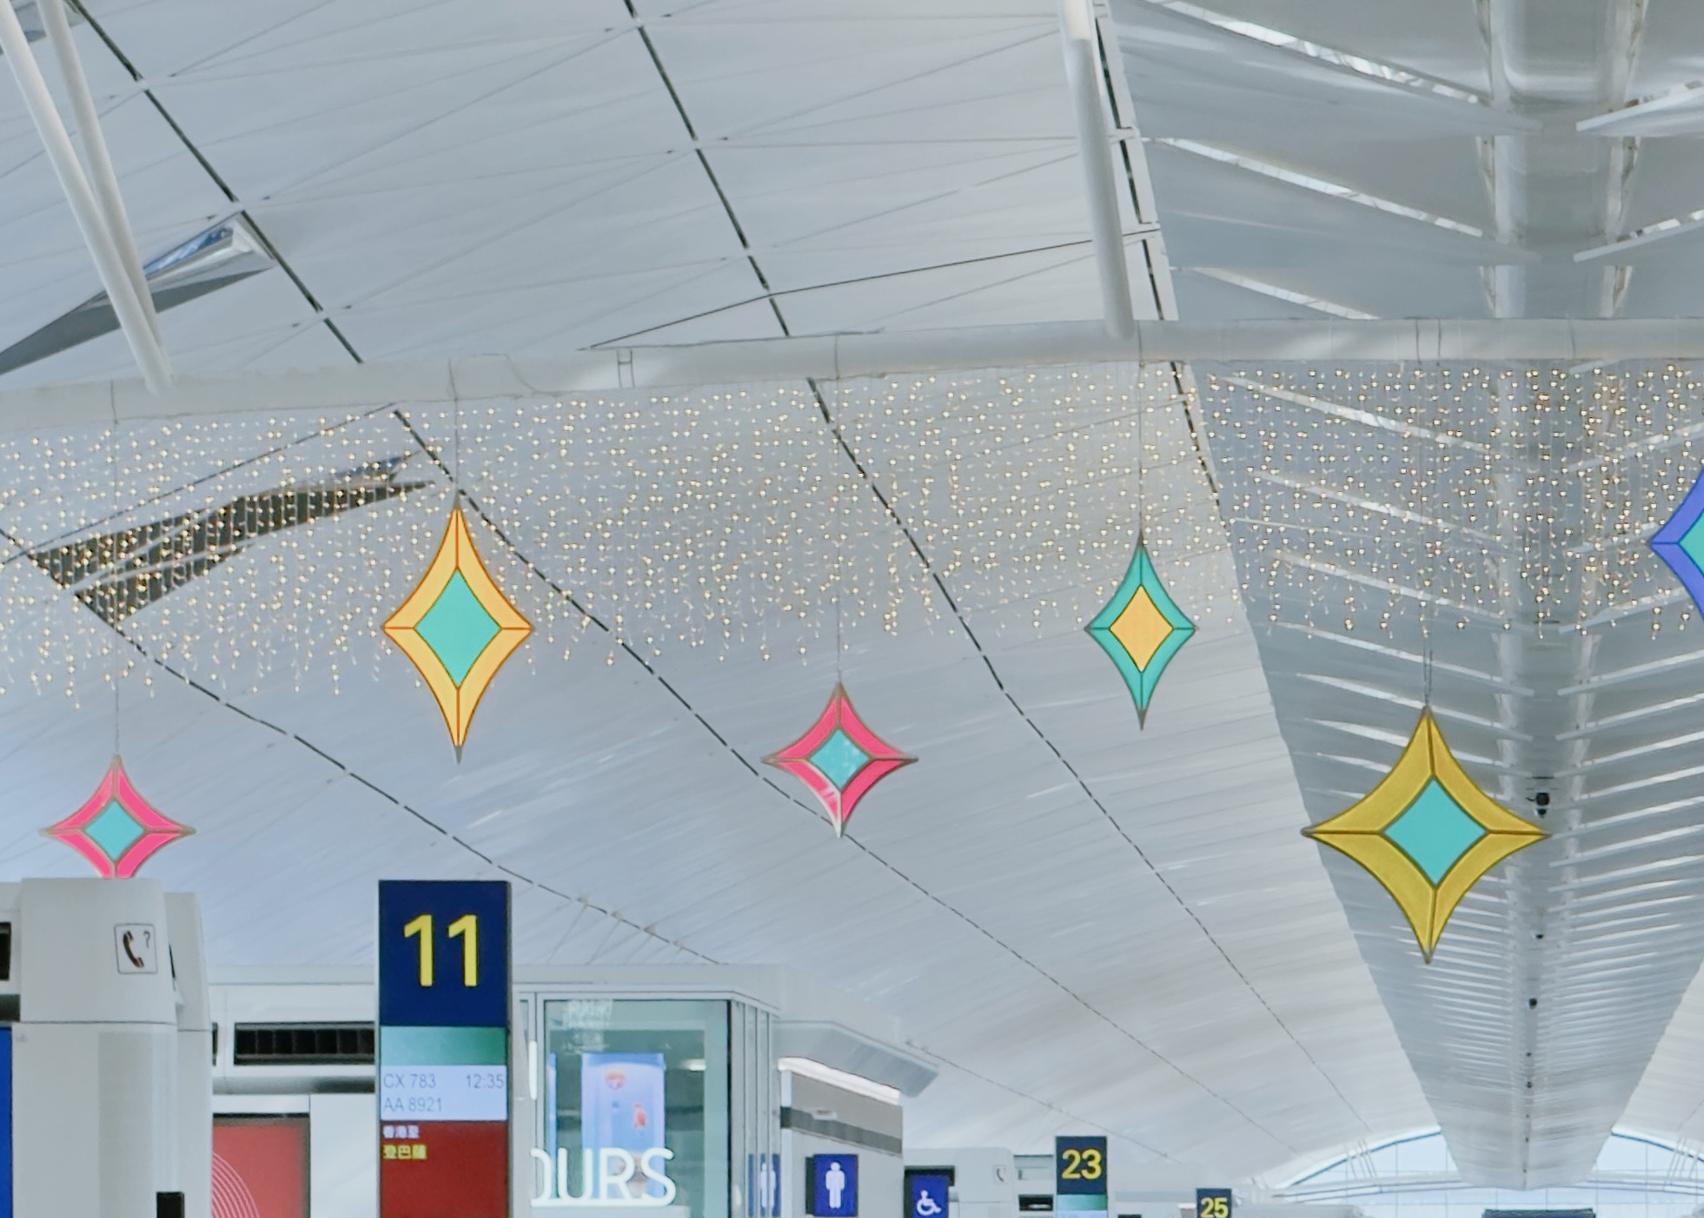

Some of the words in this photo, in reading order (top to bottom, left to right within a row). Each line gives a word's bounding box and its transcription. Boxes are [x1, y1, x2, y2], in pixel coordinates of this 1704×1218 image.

[403, 914, 480, 988] 11
[383, 1073, 406, 1089] CX
[410, 1073, 437, 1089] 783
[465, 1073, 505, 1089] 12:35
[382, 1097, 405, 1113] AA
[408, 1097, 443, 1113] 8921
[1061, 1148, 1102, 1180] 23
